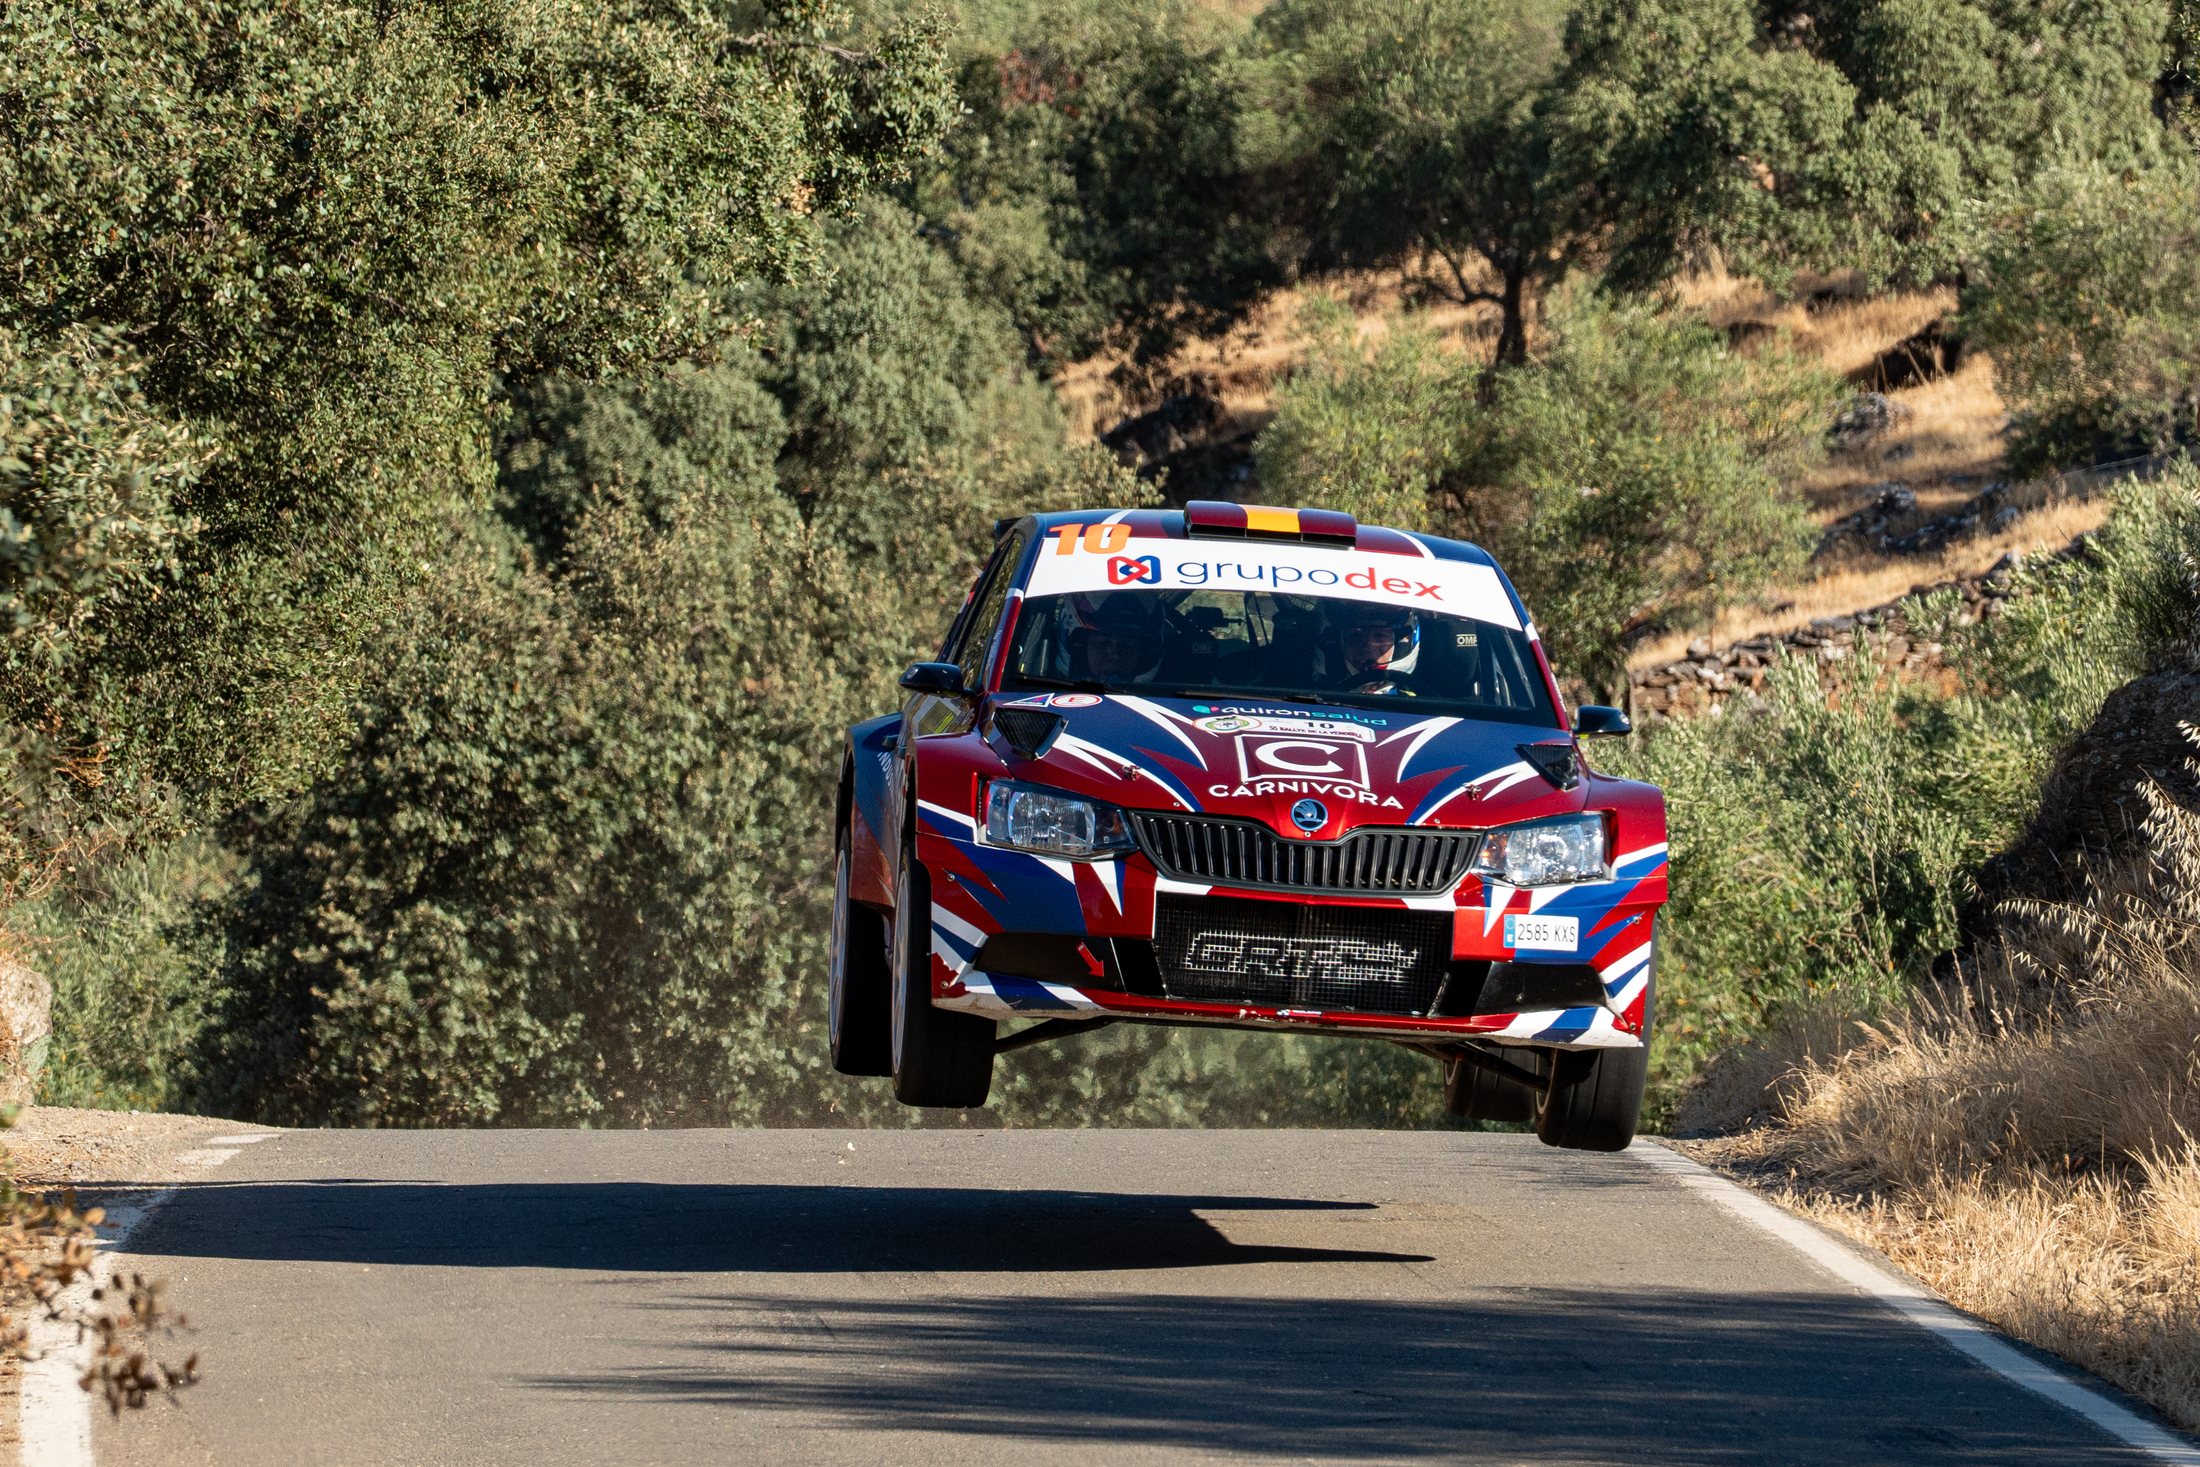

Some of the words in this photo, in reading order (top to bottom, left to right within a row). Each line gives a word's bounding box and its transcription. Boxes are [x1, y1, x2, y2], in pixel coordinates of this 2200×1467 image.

[1049, 523, 1132, 556] 10
[1176, 555, 1445, 601] grupodex
[1208, 781, 1404, 810] CARNIVORA
[1506, 934, 1514, 942] E
[1517, 923, 1549, 941] 2585
[1554, 925, 1576, 943] KXS
